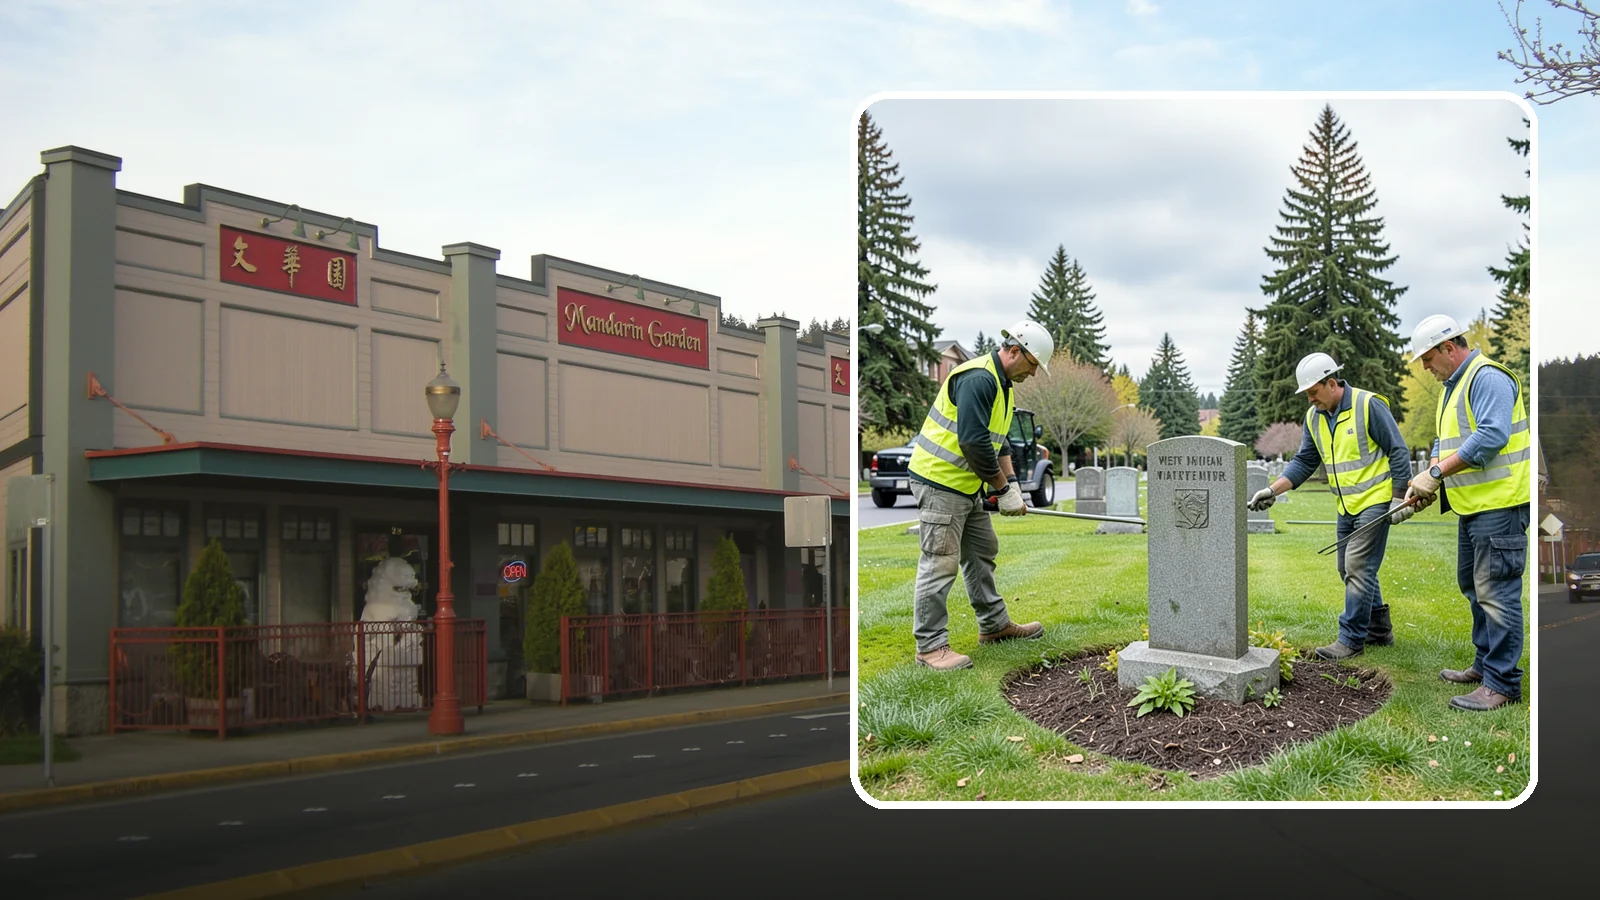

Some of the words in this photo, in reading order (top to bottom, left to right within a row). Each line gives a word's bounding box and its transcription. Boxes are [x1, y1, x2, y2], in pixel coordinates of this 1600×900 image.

[231, 236, 346, 291] 文華園
[565, 303, 643, 340] Mandarin
[648, 320, 701, 352] Garden
[504, 565, 526, 578] OPEN
